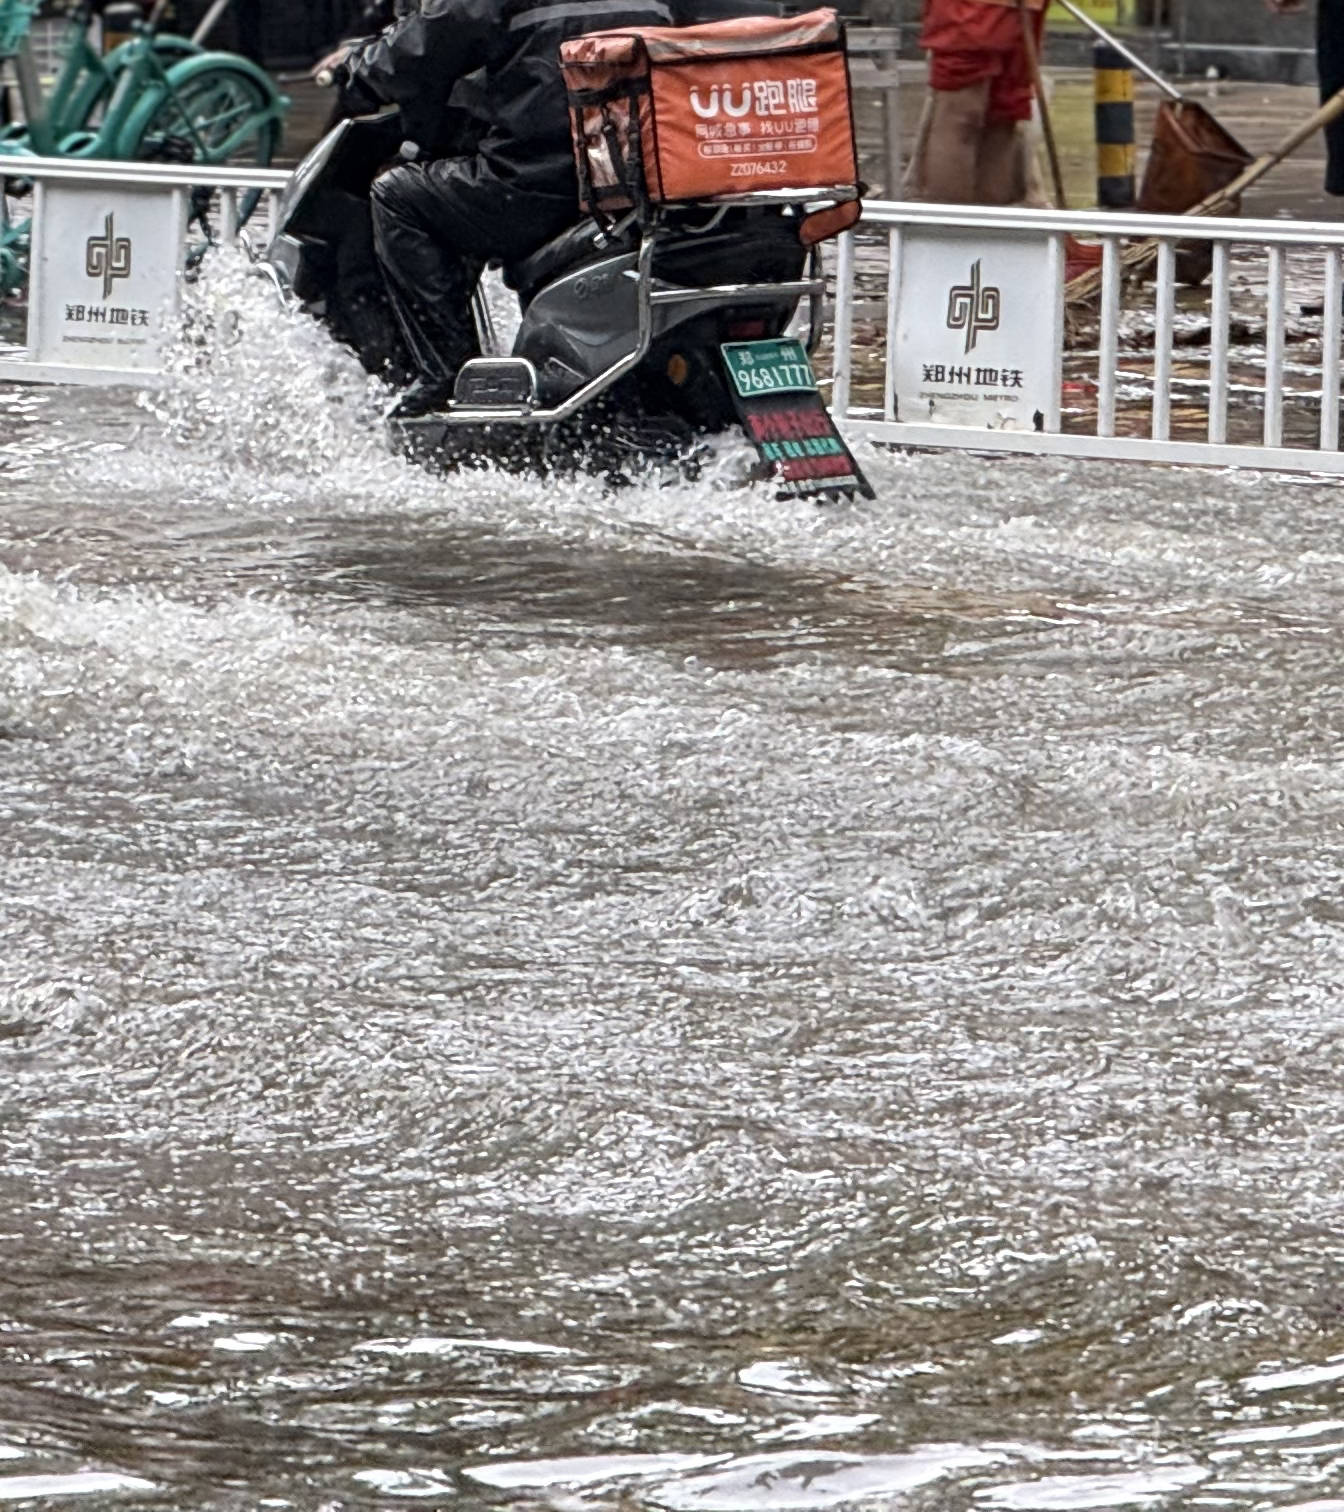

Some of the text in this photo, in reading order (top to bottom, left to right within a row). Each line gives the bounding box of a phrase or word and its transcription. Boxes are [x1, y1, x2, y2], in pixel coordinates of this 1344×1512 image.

[689, 78, 818, 118] UU跑腿
[65, 304, 149, 327] 郑州地铁
[738, 364, 812, 390] 9681777
[922, 363, 1024, 388] 郑州地铁
